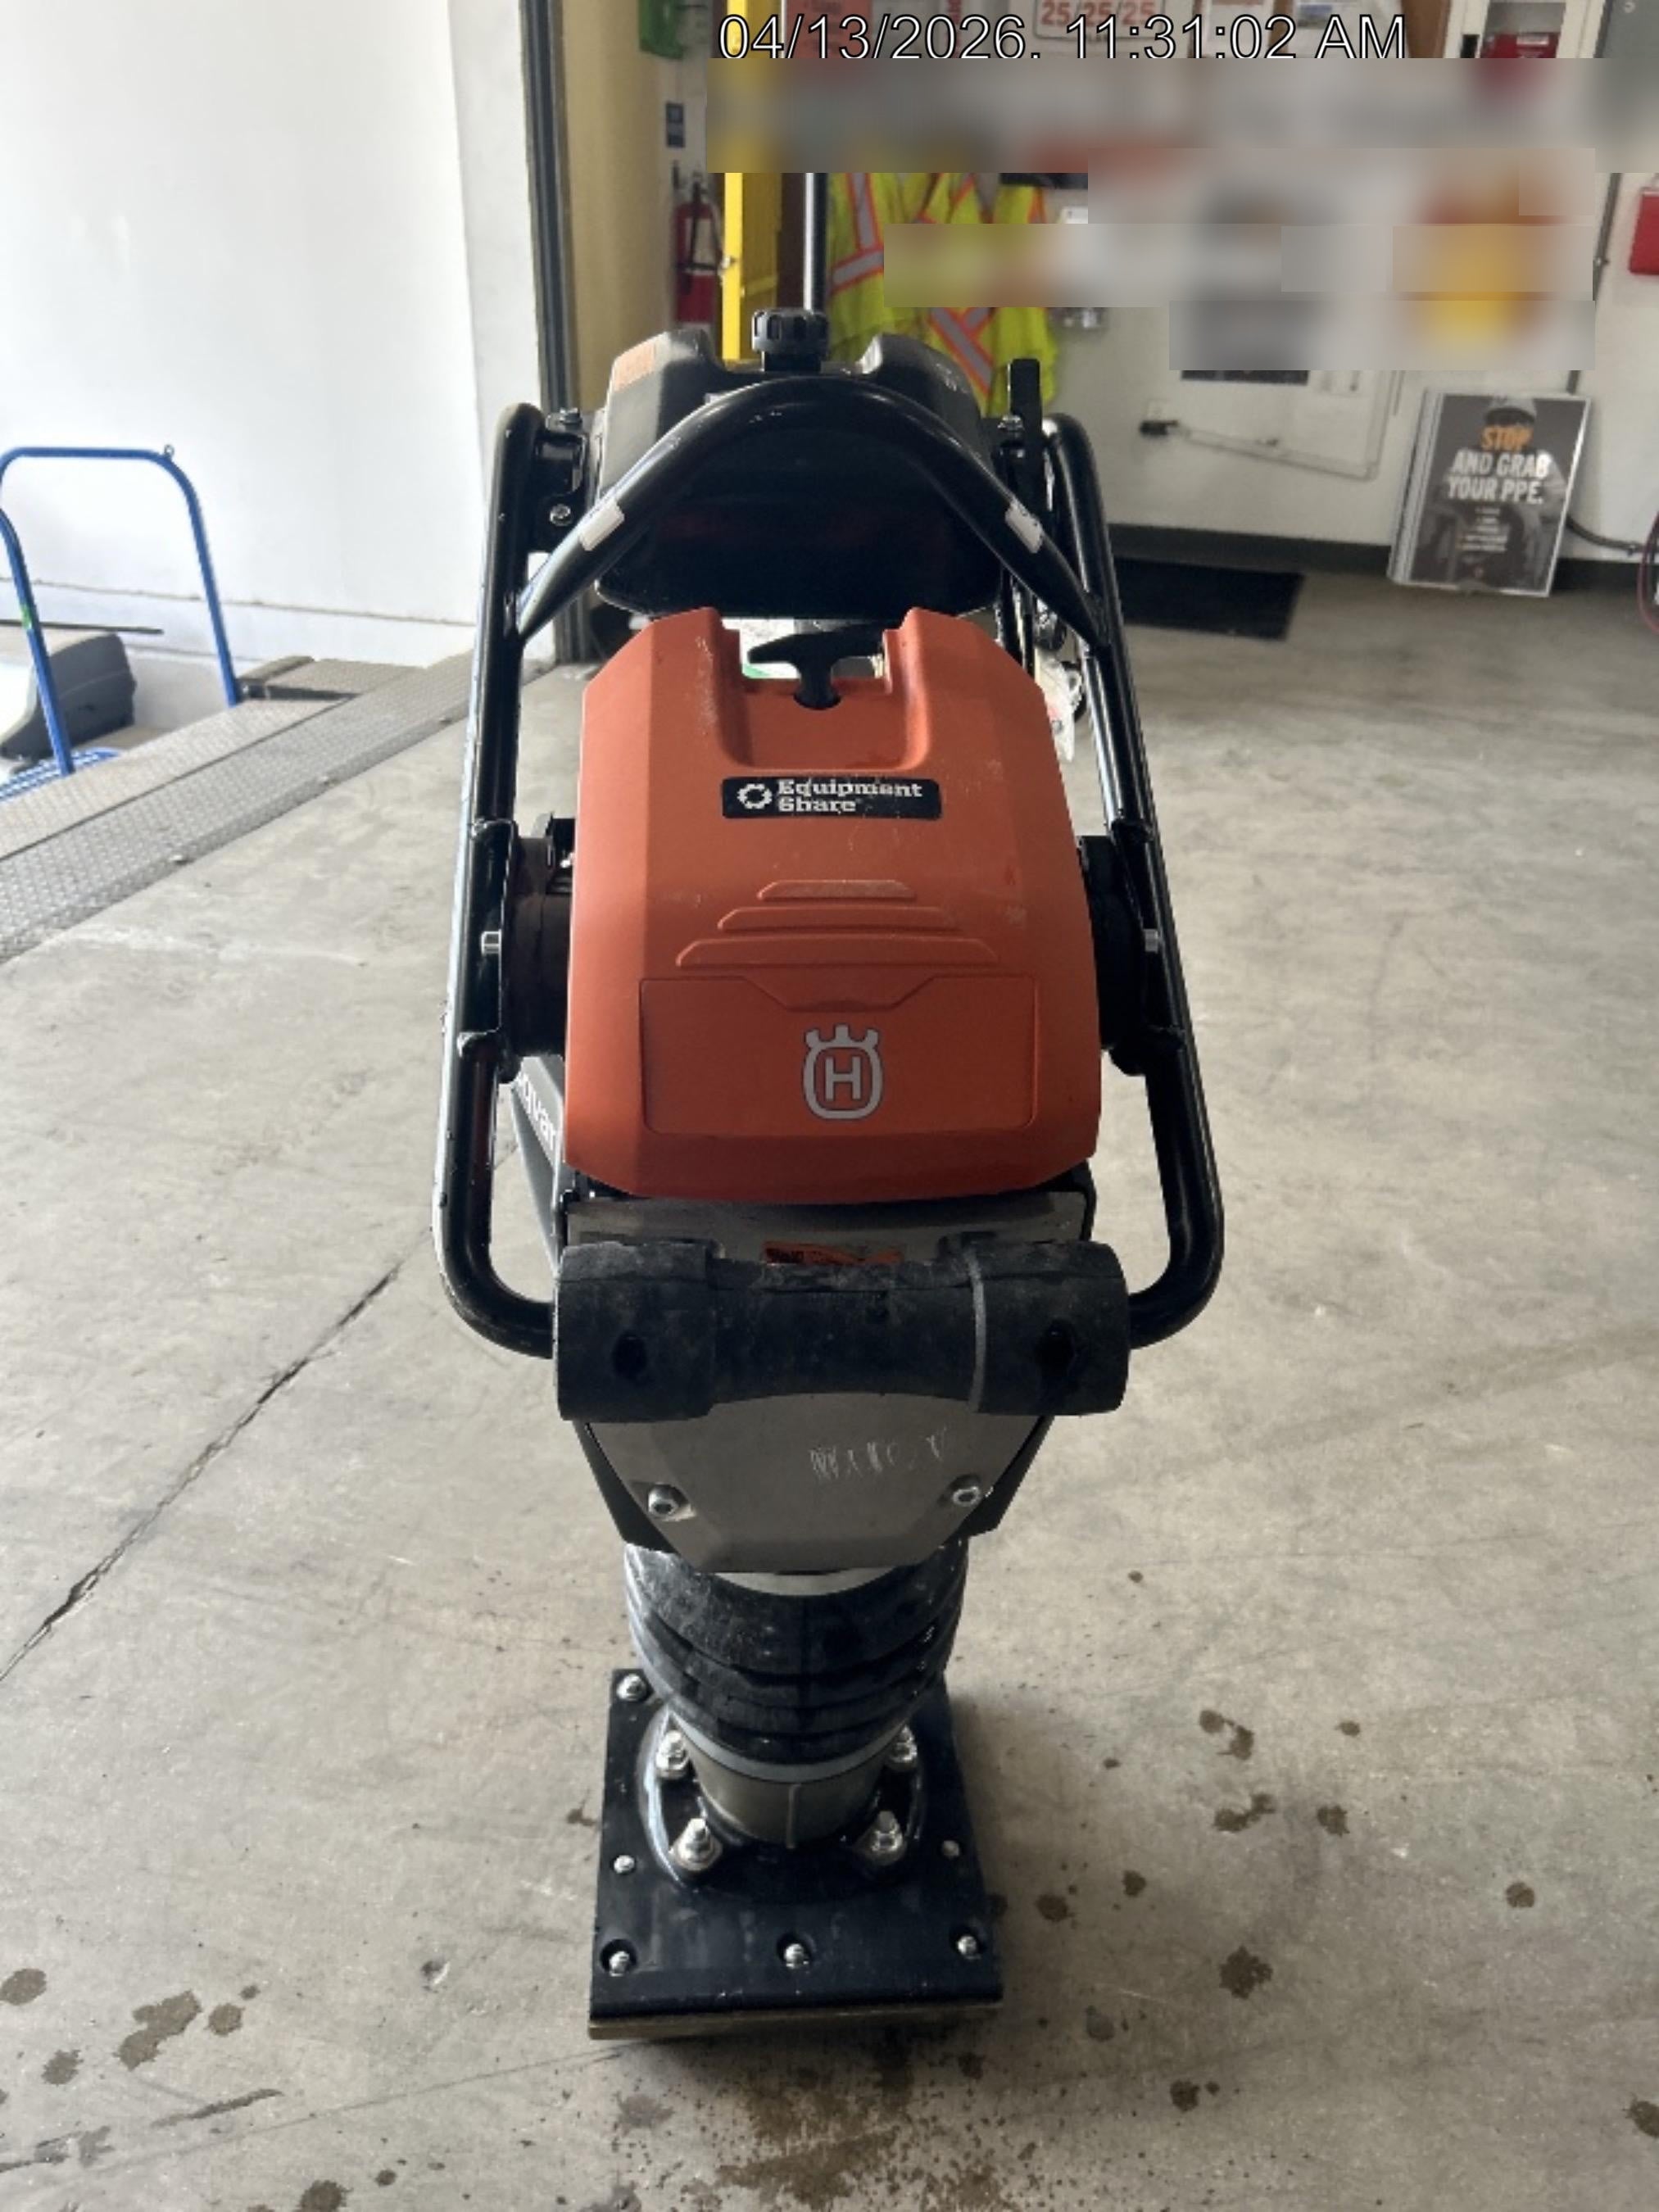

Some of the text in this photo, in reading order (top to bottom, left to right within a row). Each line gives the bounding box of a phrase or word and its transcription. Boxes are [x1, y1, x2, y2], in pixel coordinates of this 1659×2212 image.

[1451, 450, 1552, 479] AND GRAB
[1448, 476, 1498, 501] YOUR
[777, 778, 923, 798] Equipment
[778, 796, 857, 813] Share
